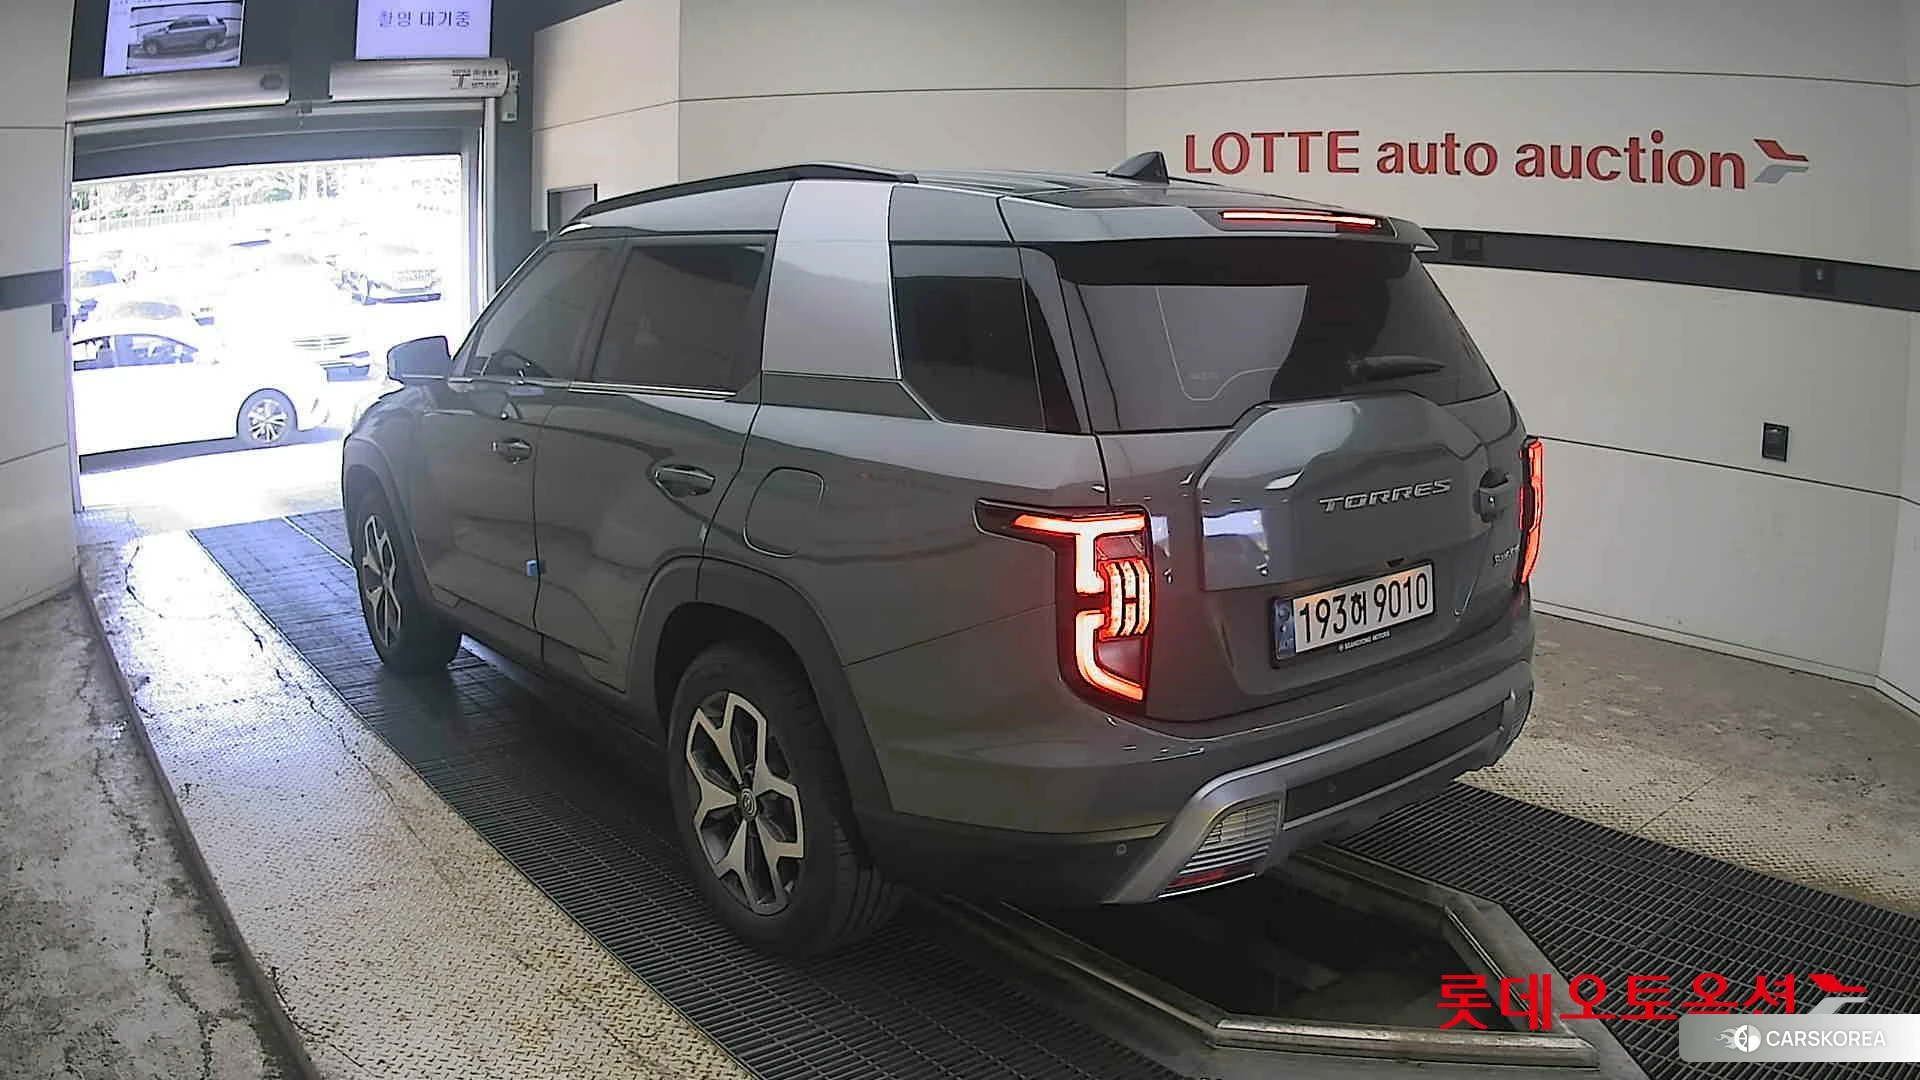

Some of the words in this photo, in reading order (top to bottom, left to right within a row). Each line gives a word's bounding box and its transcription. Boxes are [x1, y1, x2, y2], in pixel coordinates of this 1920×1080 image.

[1185, 131, 1360, 174] LOTTE
[1377, 133, 1498, 176] auto
[1515, 130, 1746, 189] auction
[1319, 479, 1451, 512] TORRES
